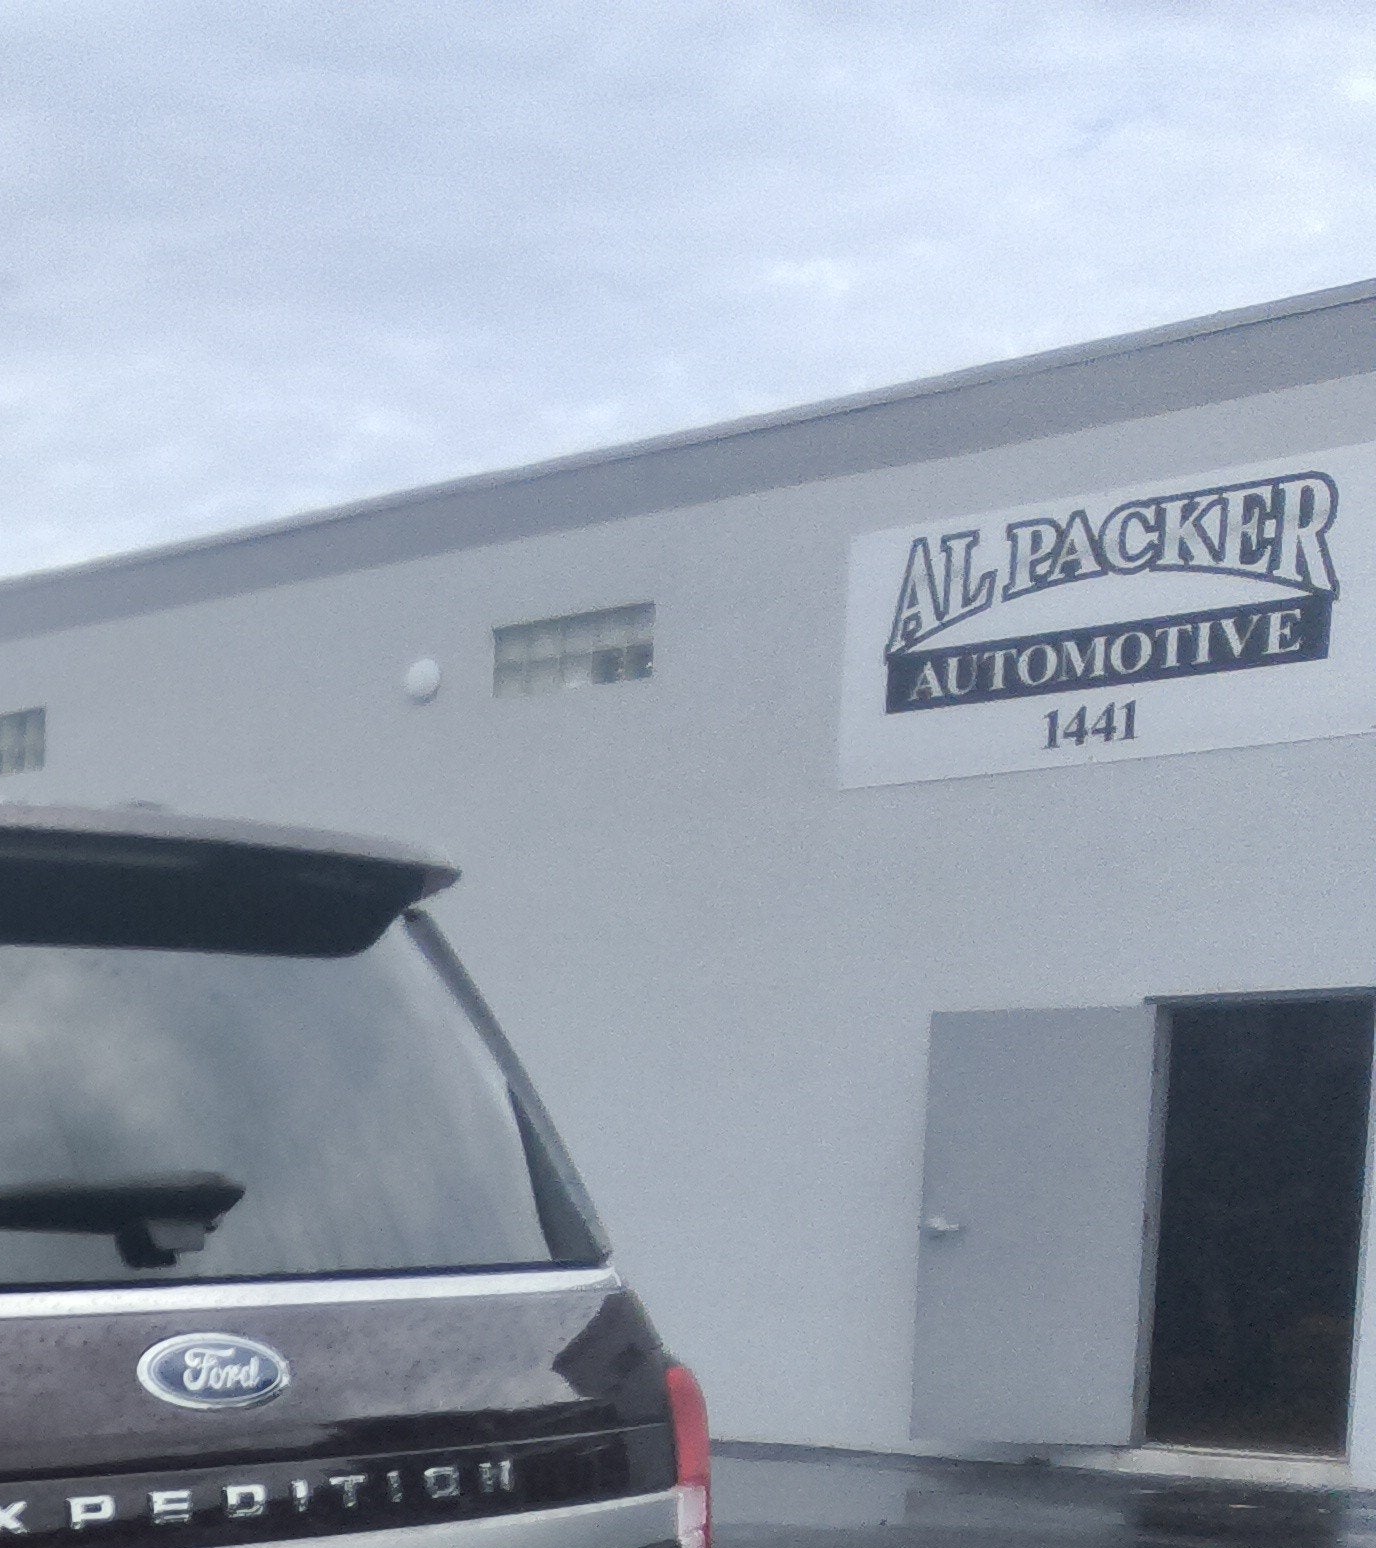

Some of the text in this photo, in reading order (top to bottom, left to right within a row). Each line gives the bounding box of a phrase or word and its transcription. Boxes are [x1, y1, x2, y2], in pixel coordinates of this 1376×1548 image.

[885, 470, 1339, 656] AL PACKER
[907, 608, 1302, 701] AUTOMOTIVE
[1041, 699, 1137, 750] 1441
[183, 1346, 261, 1392] Ford
